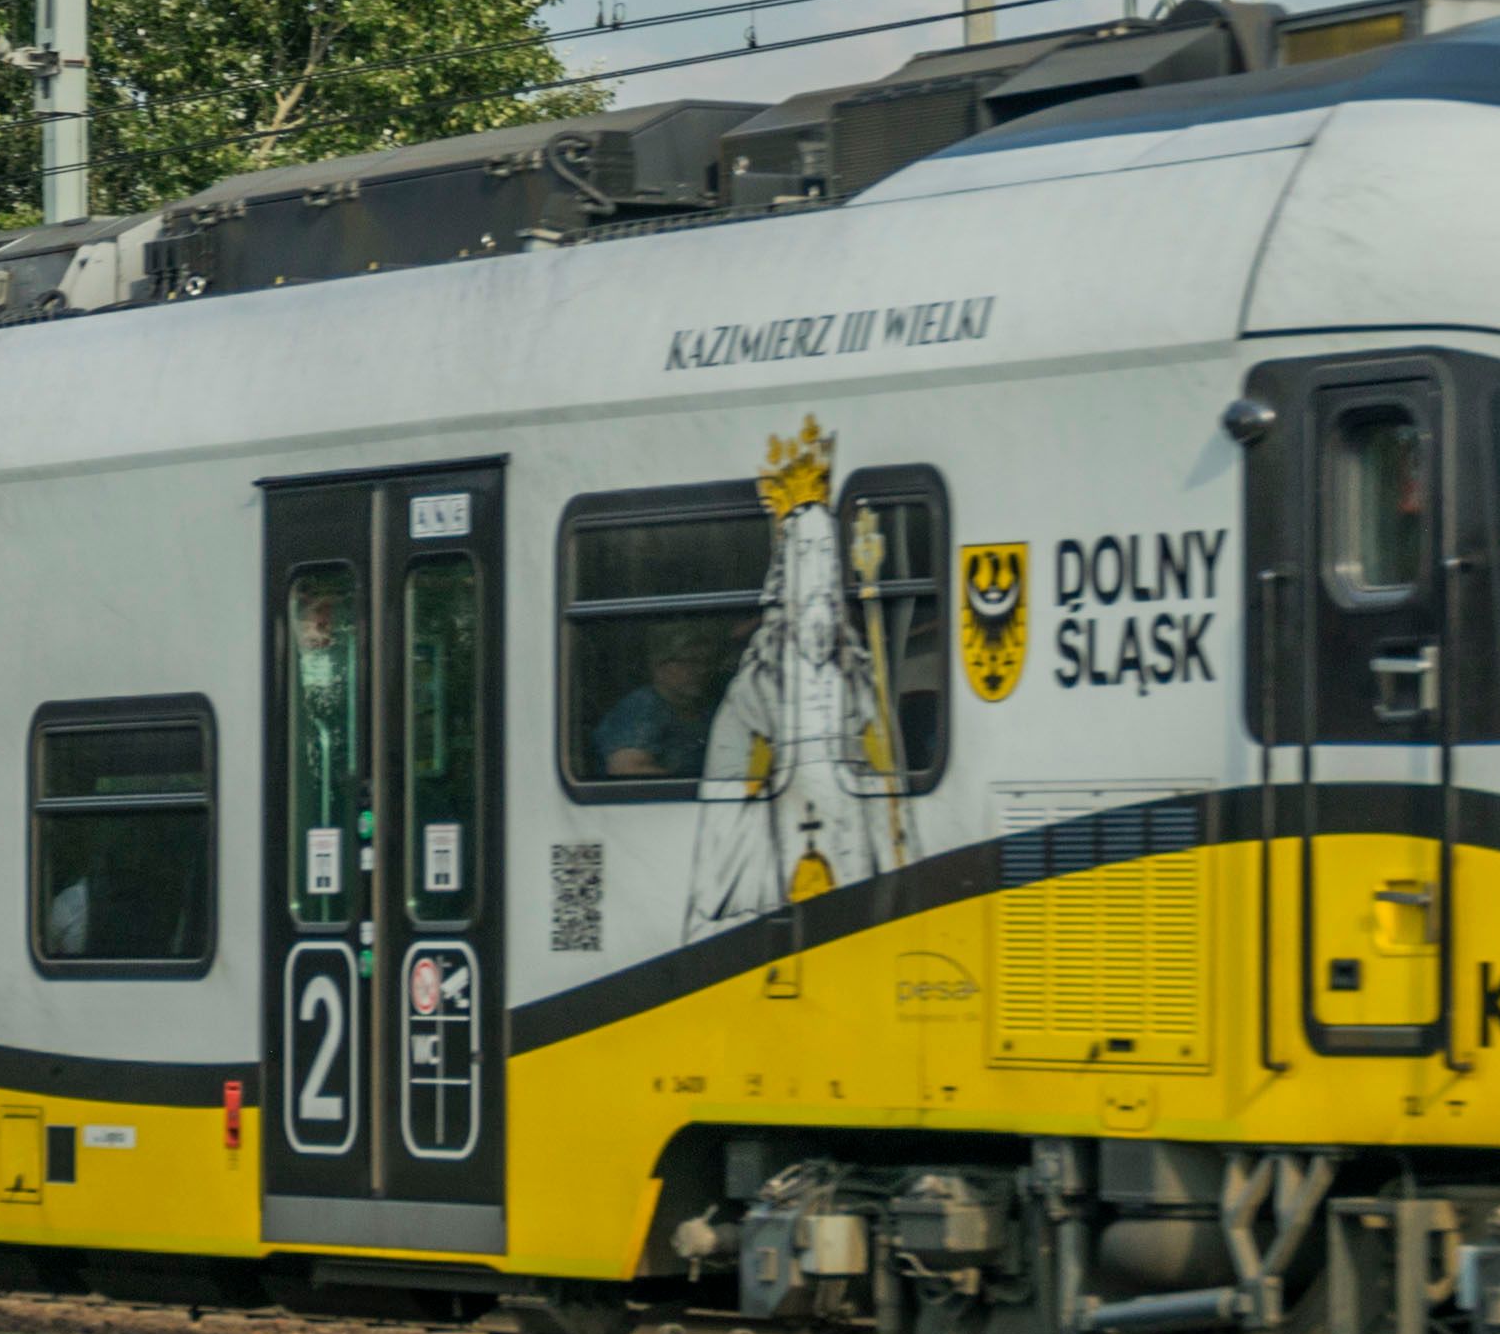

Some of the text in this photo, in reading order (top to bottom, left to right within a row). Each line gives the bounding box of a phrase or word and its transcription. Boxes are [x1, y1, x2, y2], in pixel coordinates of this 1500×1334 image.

[664, 295, 997, 371] KAZIMIERZ III WIELKI
[1054, 527, 1228, 607] DOLNY
[1053, 601, 1216, 697] ŚLĄSK
[299, 975, 343, 1120] 2
[411, 1034, 442, 1066] WC
